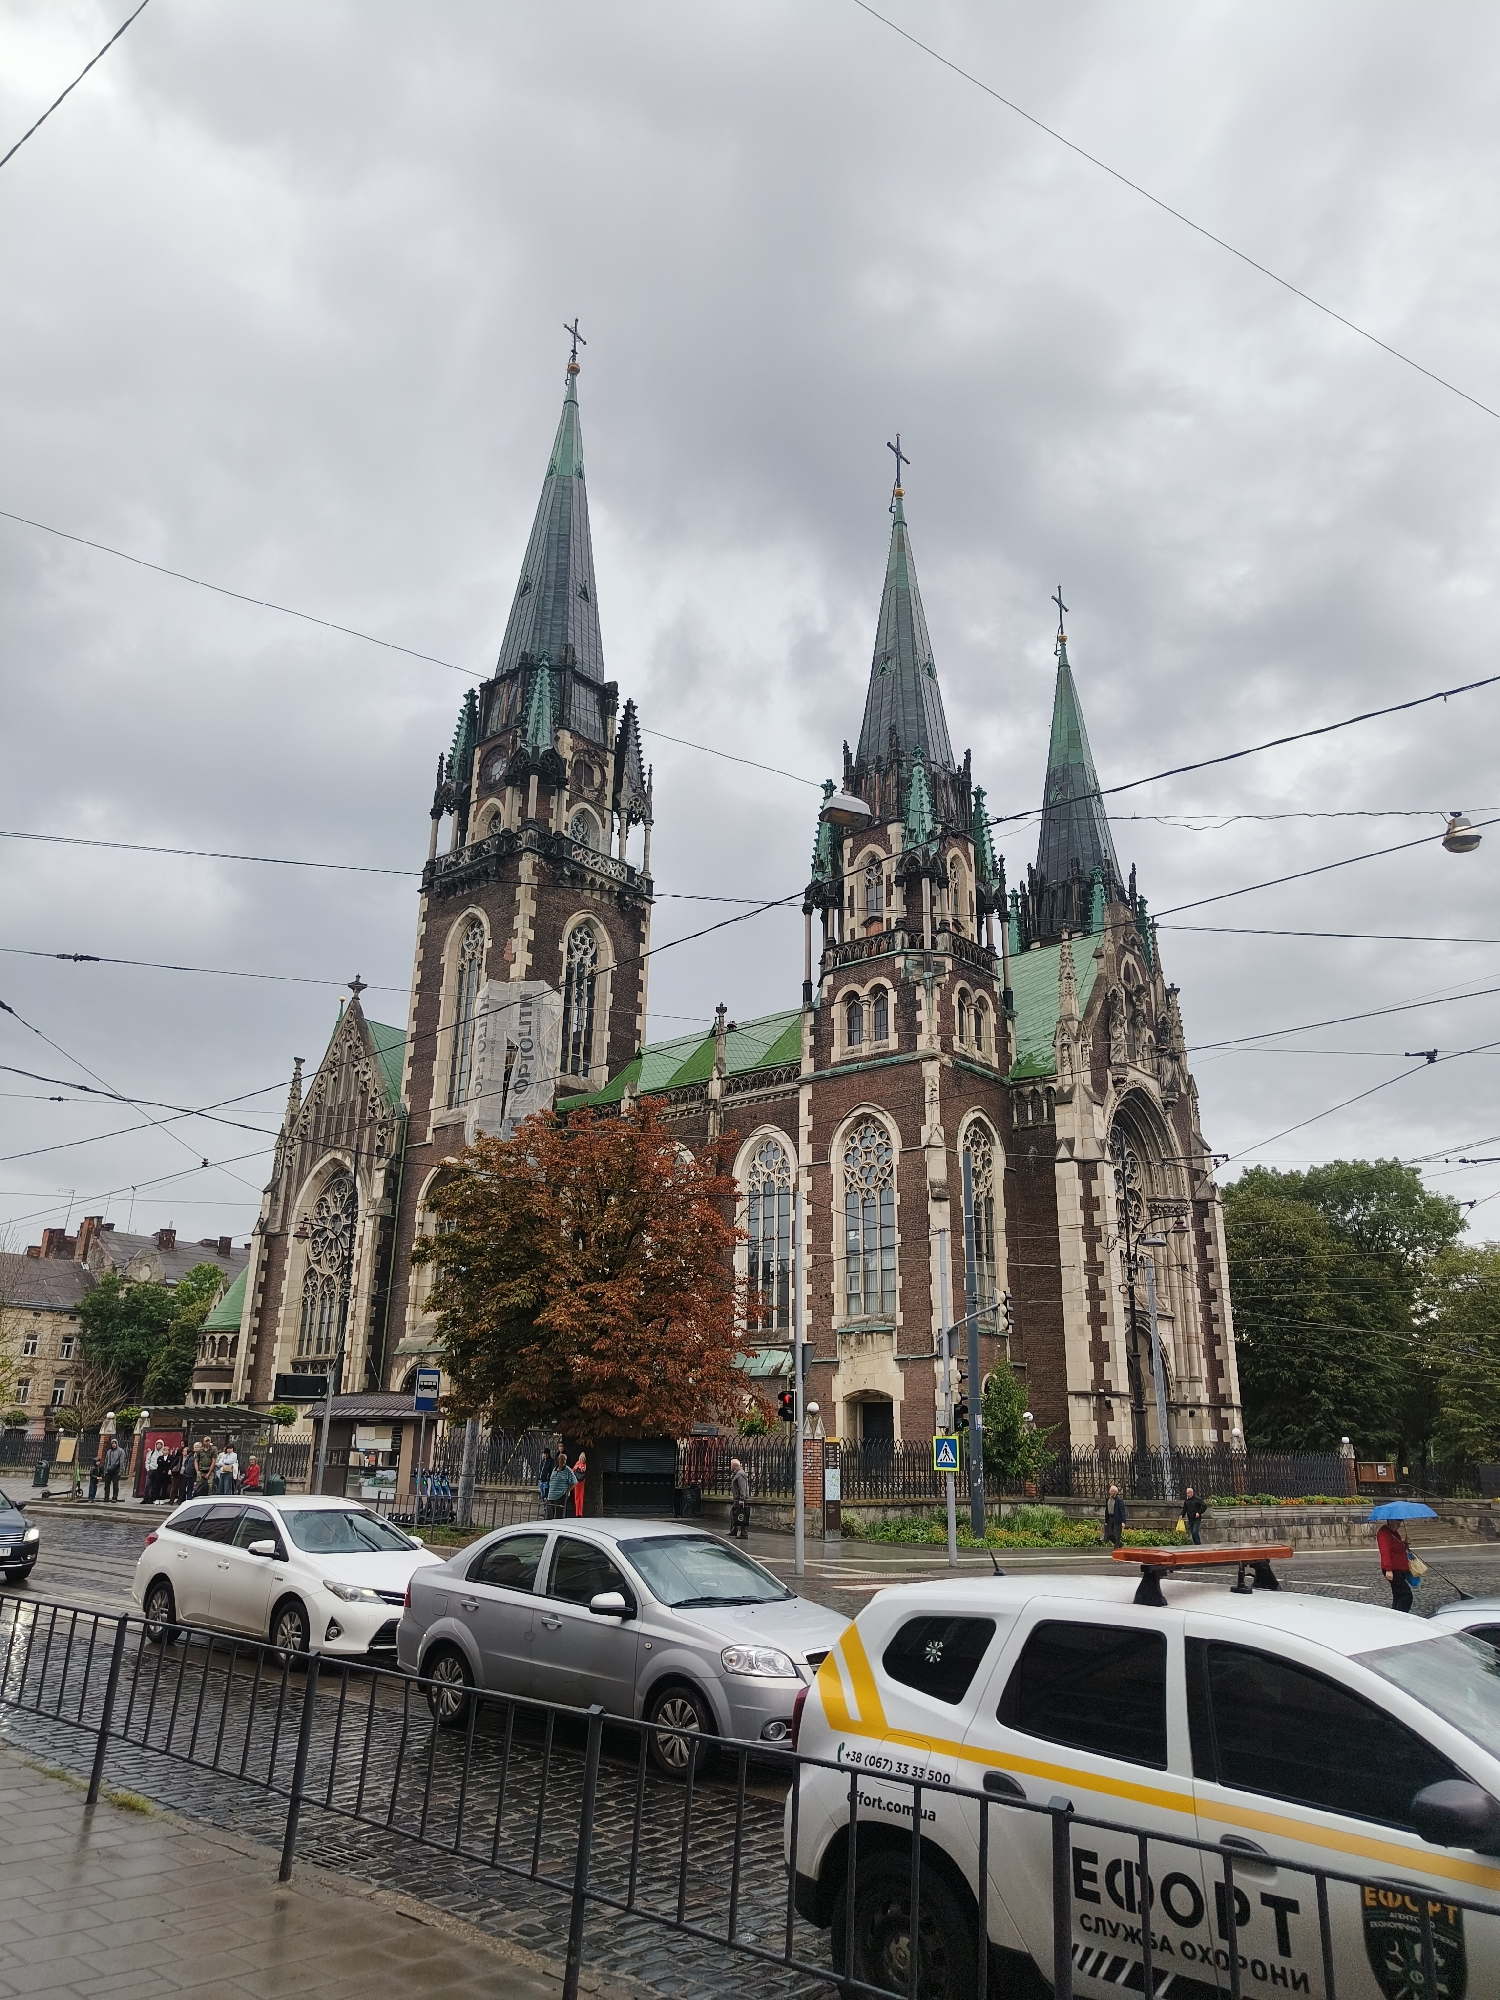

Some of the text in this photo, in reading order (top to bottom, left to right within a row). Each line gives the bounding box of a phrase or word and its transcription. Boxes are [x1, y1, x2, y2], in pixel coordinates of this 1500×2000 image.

[514, 993, 535, 1095] OPTOLITH
[845, 1750, 951, 1785] +38 (067) 33 33 500
[847, 1790, 936, 1822] efort.comua
[1072, 1847, 1300, 1958] ЕФОРТ
[1079, 1912, 1176, 1956] СЛУЖБА
